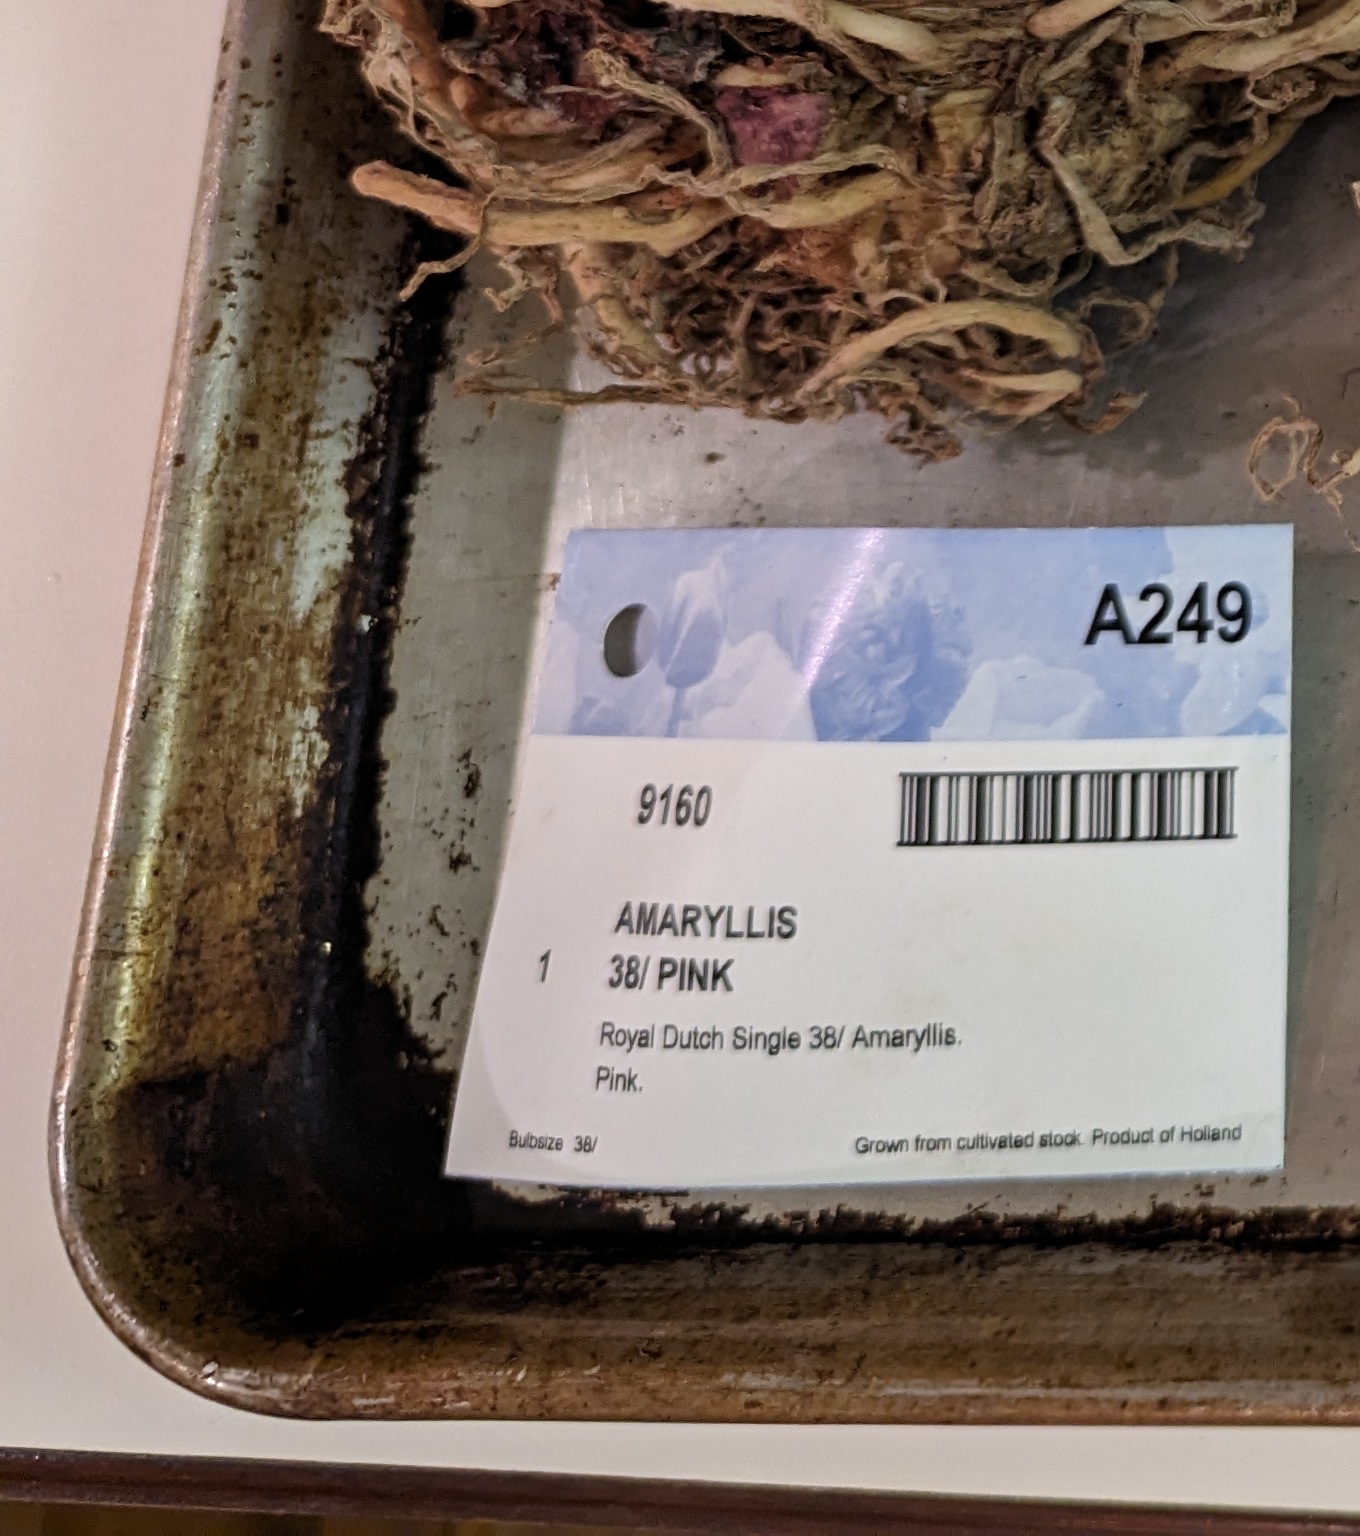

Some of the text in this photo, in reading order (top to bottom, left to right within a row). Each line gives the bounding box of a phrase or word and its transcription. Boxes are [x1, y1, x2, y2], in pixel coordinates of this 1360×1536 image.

[1084, 582, 1252, 645] A249
[637, 784, 712, 827] 9160
[614, 902, 797, 940] AMARYLLIS
[539, 949, 551, 983] 1
[608, 954, 734, 992] 38/ PINK
[600, 1021, 961, 1056] Royal Dutch Single 38/ Amaryllis.
[595, 1066, 642, 1092] Pink.
[508, 1130, 598, 1154] Bulbsize 38/
[855, 1137, 909, 1155] Grown
[914, 1134, 952, 1153] from
[956, 1132, 1034, 1152] cultivated
[1091, 1128, 1154, 1146] Product
[1159, 1126, 1176, 1144] of
[1180, 1124, 1242, 1143] Holland
